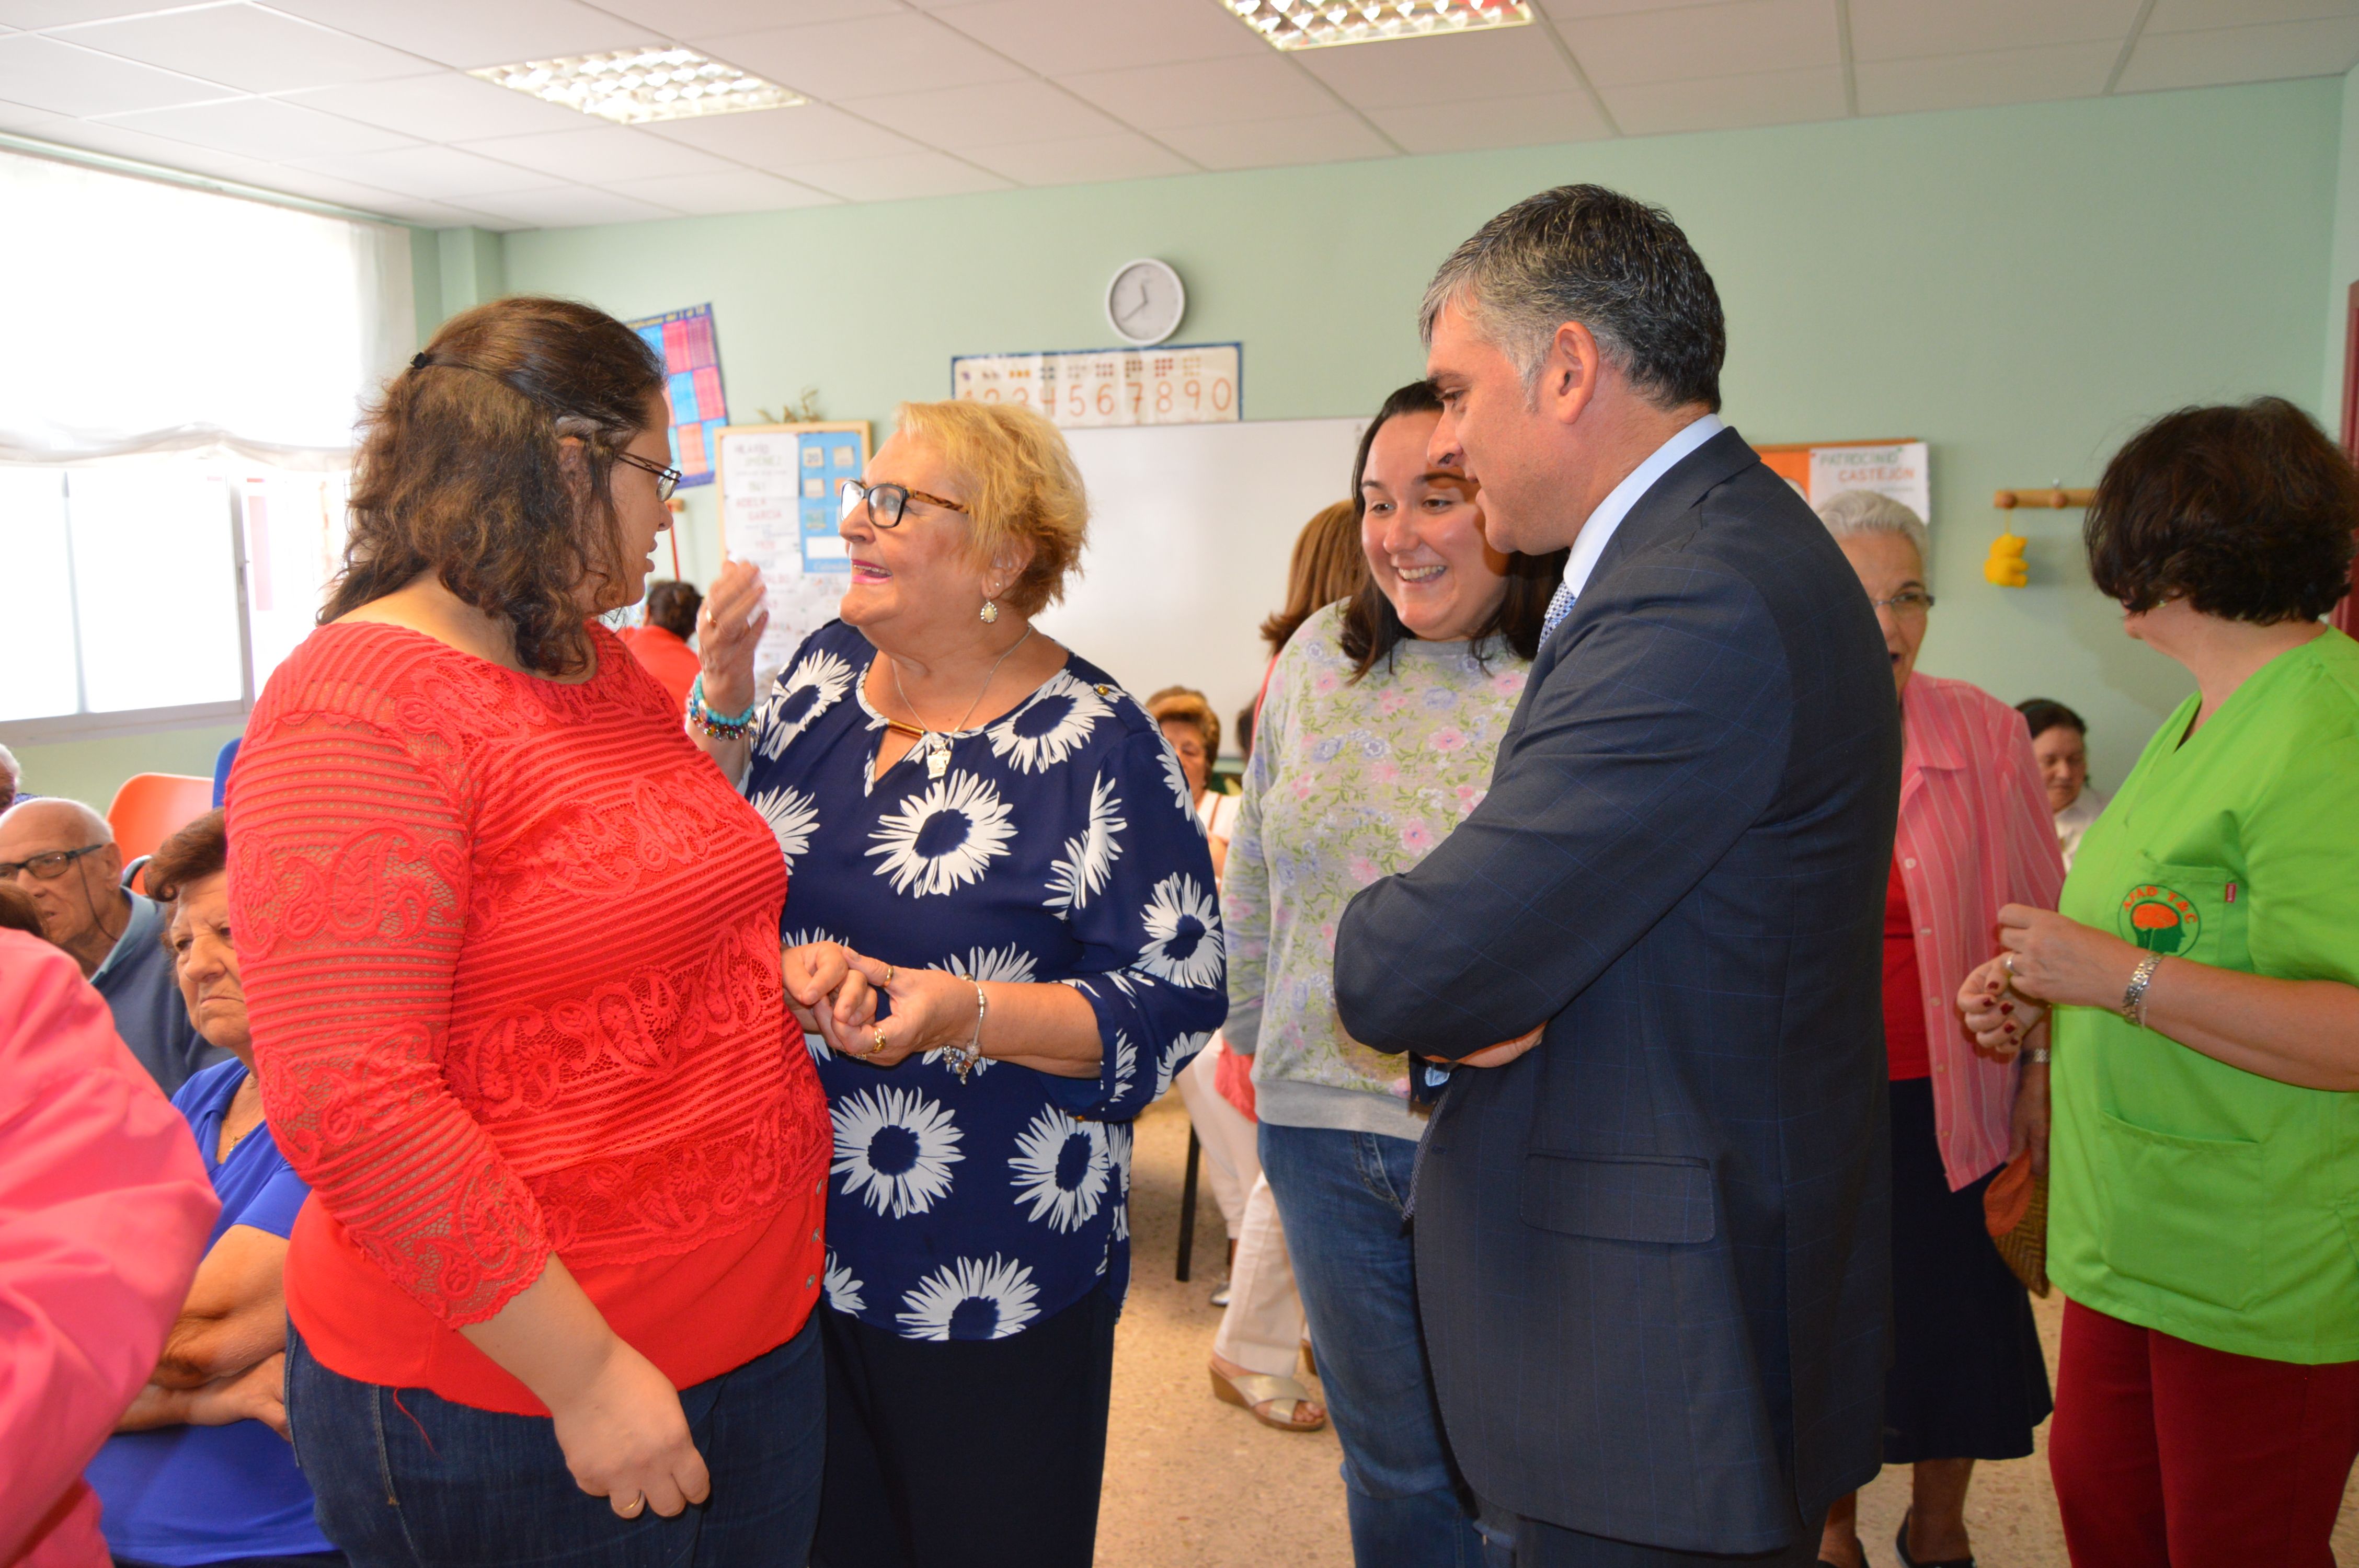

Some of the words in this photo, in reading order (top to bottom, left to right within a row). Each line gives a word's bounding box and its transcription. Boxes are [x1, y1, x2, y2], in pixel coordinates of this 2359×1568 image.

[1039, 385, 1057, 417] 4
[1068, 383, 1086, 416] 5
[1096, 382, 1115, 416] 6
[1126, 382, 1143, 414] 7
[1156, 381, 1173, 414] 8
[1185, 379, 1200, 411] 9
[1212, 377, 1232, 412] 0
